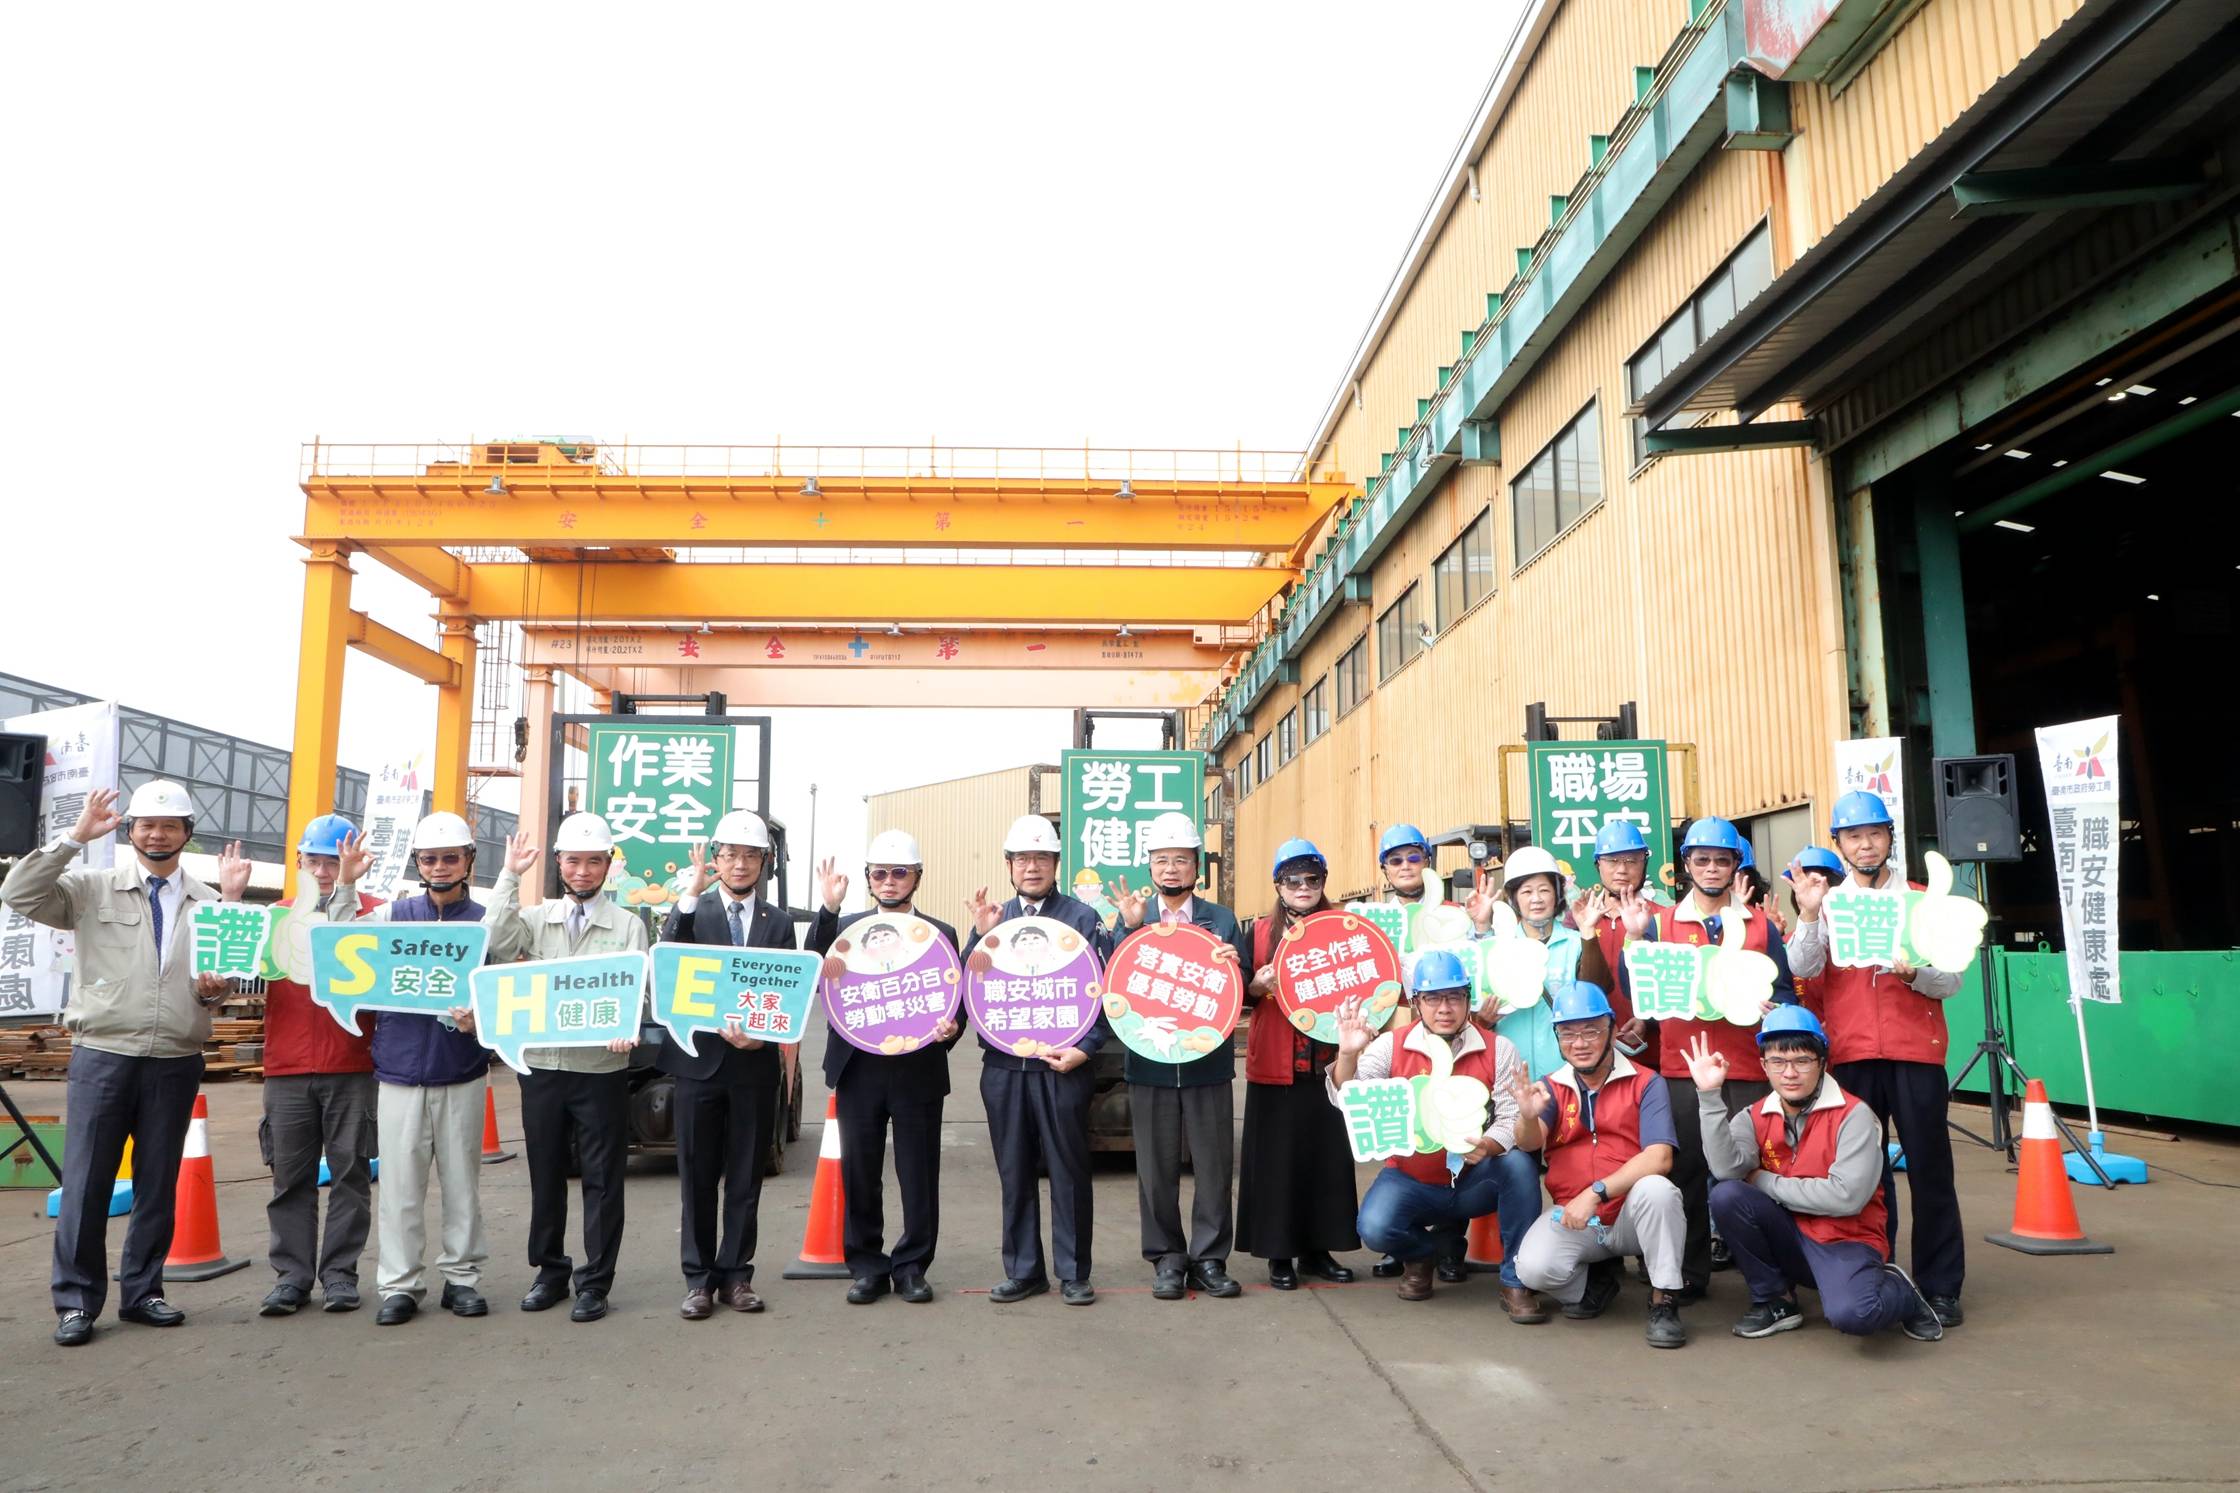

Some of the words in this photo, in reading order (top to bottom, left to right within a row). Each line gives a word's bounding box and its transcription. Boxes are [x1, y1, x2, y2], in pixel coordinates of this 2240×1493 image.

[608, 735, 715, 787] 作業
[1546, 752, 1648, 803] 職場
[1081, 761, 1184, 812] 勞工
[605, 792, 711, 844] 安全
[1829, 892, 1899, 962] 讚
[2081, 816, 2111, 1001] 職安健康處
[194, 905, 264, 975] 讚
[390, 938, 470, 962] Safety
[1285, 933, 1372, 978] 安全作業
[329, 934, 379, 996] S
[393, 967, 455, 995] 安全
[554, 971, 635, 992] Health
[671, 955, 722, 1018] E
[730, 972, 799, 988] Together
[732, 957, 802, 975] Everyone
[840, 967, 941, 1007] 安衛百分百
[1133, 943, 1228, 995] 落實安衛
[1294, 958, 1381, 1004] 健康無價
[1630, 947, 1697, 1017] 讚
[496, 973, 548, 1035] H
[558, 999, 618, 1028] 健康
[738, 991, 780, 1011] 大家
[844, 991, 946, 1031] 勞動零災害
[983, 976, 1078, 1003] 職安城市
[1126, 970, 1219, 1021] 優質勞動
[726, 1011, 789, 1031] 一起來
[984, 1005, 1079, 1031] 希望家園
[1343, 1084, 1410, 1157] 讚
